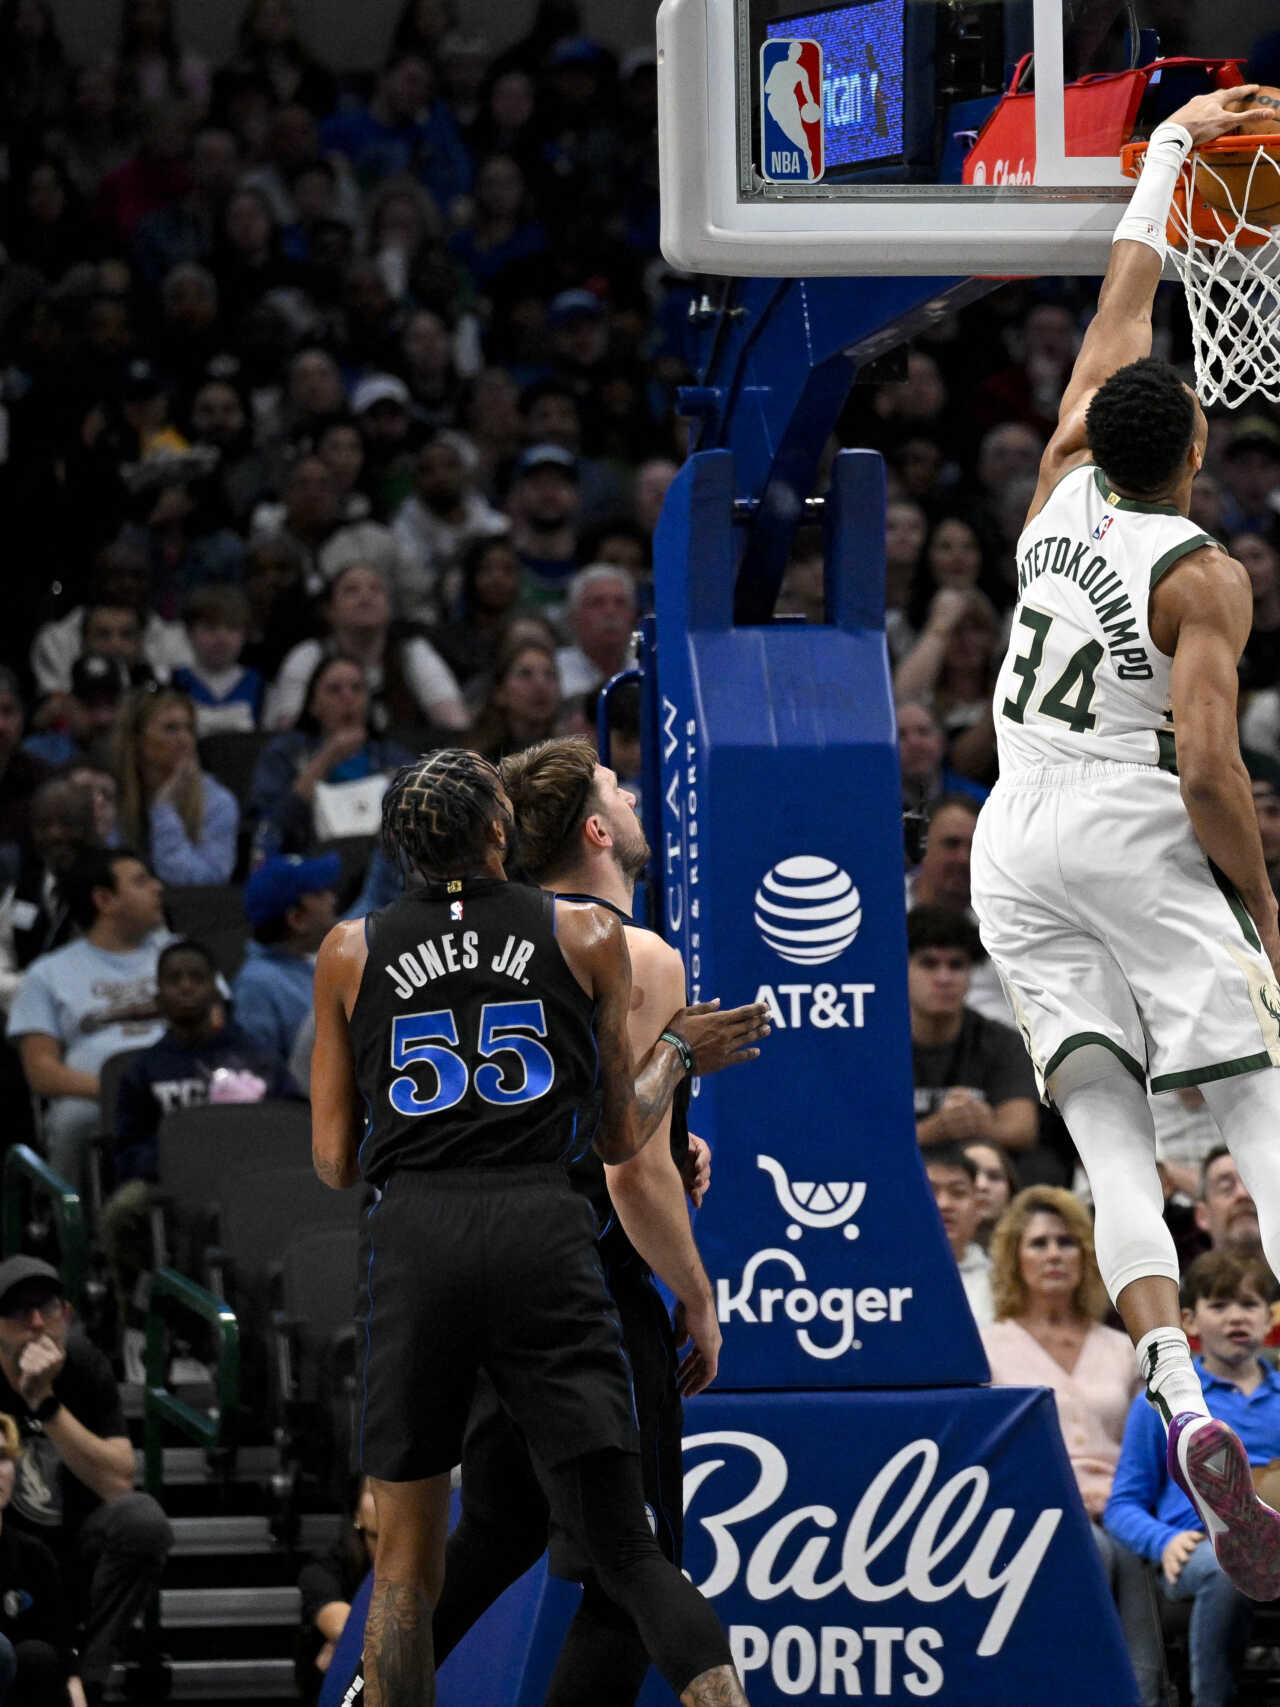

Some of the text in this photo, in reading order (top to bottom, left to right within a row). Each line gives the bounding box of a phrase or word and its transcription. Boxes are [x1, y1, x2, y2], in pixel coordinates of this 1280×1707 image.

[771, 151, 801, 174] NBA
[1018, 536, 1154, 681] NTETOKOUNMPO
[1002, 605, 1105, 734] 34
[662, 695, 683, 933] CTAW
[686, 718, 699, 885] RESORTS
[385, 931, 536, 1000] JONES JR.
[755, 983, 876, 1029] AT&T
[389, 999, 556, 1117] 55
[716, 1247, 914, 1360] Kroger
[681, 1430, 1063, 1657] Bally
[728, 1624, 945, 1697] PORTS
